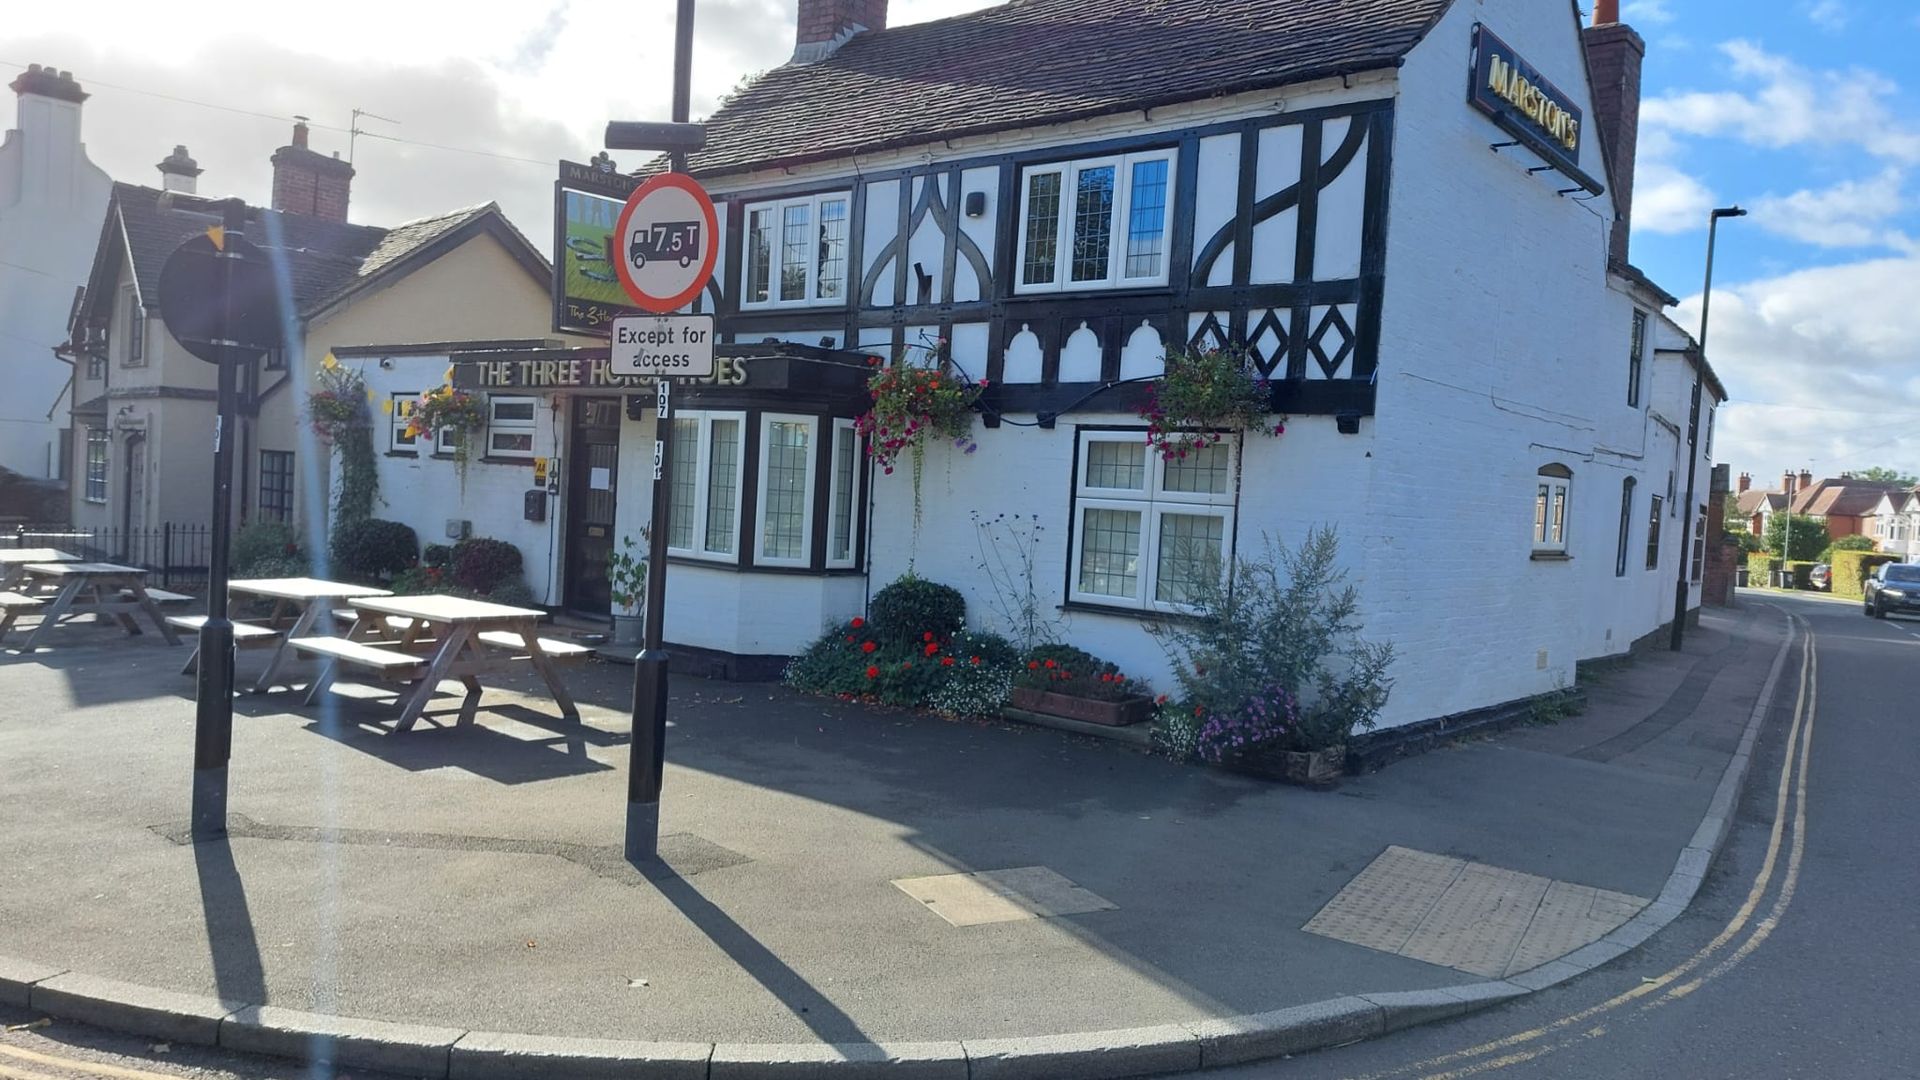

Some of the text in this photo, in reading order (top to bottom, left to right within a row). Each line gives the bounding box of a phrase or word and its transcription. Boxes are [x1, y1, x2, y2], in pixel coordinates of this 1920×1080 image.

[568, 304, 584, 319] The
[586, 306, 599, 325] 3
[618, 326, 706, 347] Except for
[632, 353, 690, 368] access
[476, 361, 512, 386] THE
[519, 360, 580, 386] THREE
[658, 383, 667, 417] 107
